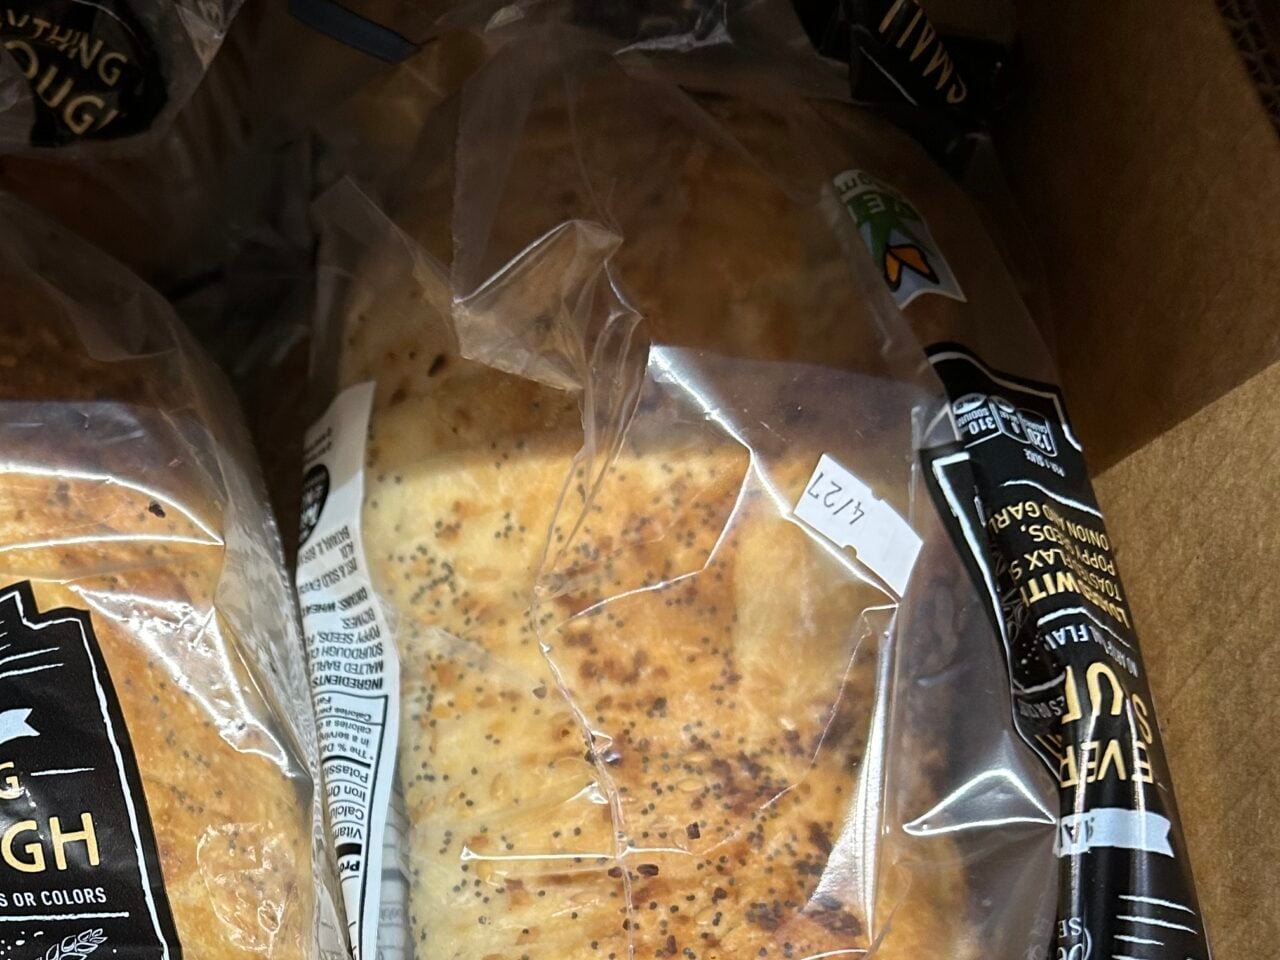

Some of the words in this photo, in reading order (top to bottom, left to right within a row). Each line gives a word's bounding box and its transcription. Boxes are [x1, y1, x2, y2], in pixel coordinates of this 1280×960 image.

[807, 472, 865, 525] 4/27
[1066, 520, 1109, 551] ONION
[322, 642, 383, 660] SOURDOUGH
[344, 660, 383, 675] MALTED
[334, 720, 371, 734] calories
[350, 746, 366, 759] The
[344, 786, 366, 802] Iron
[331, 806, 364, 820] Calciu
[13, 890, 38, 909] OR
[40, 886, 107, 906] COLORS
